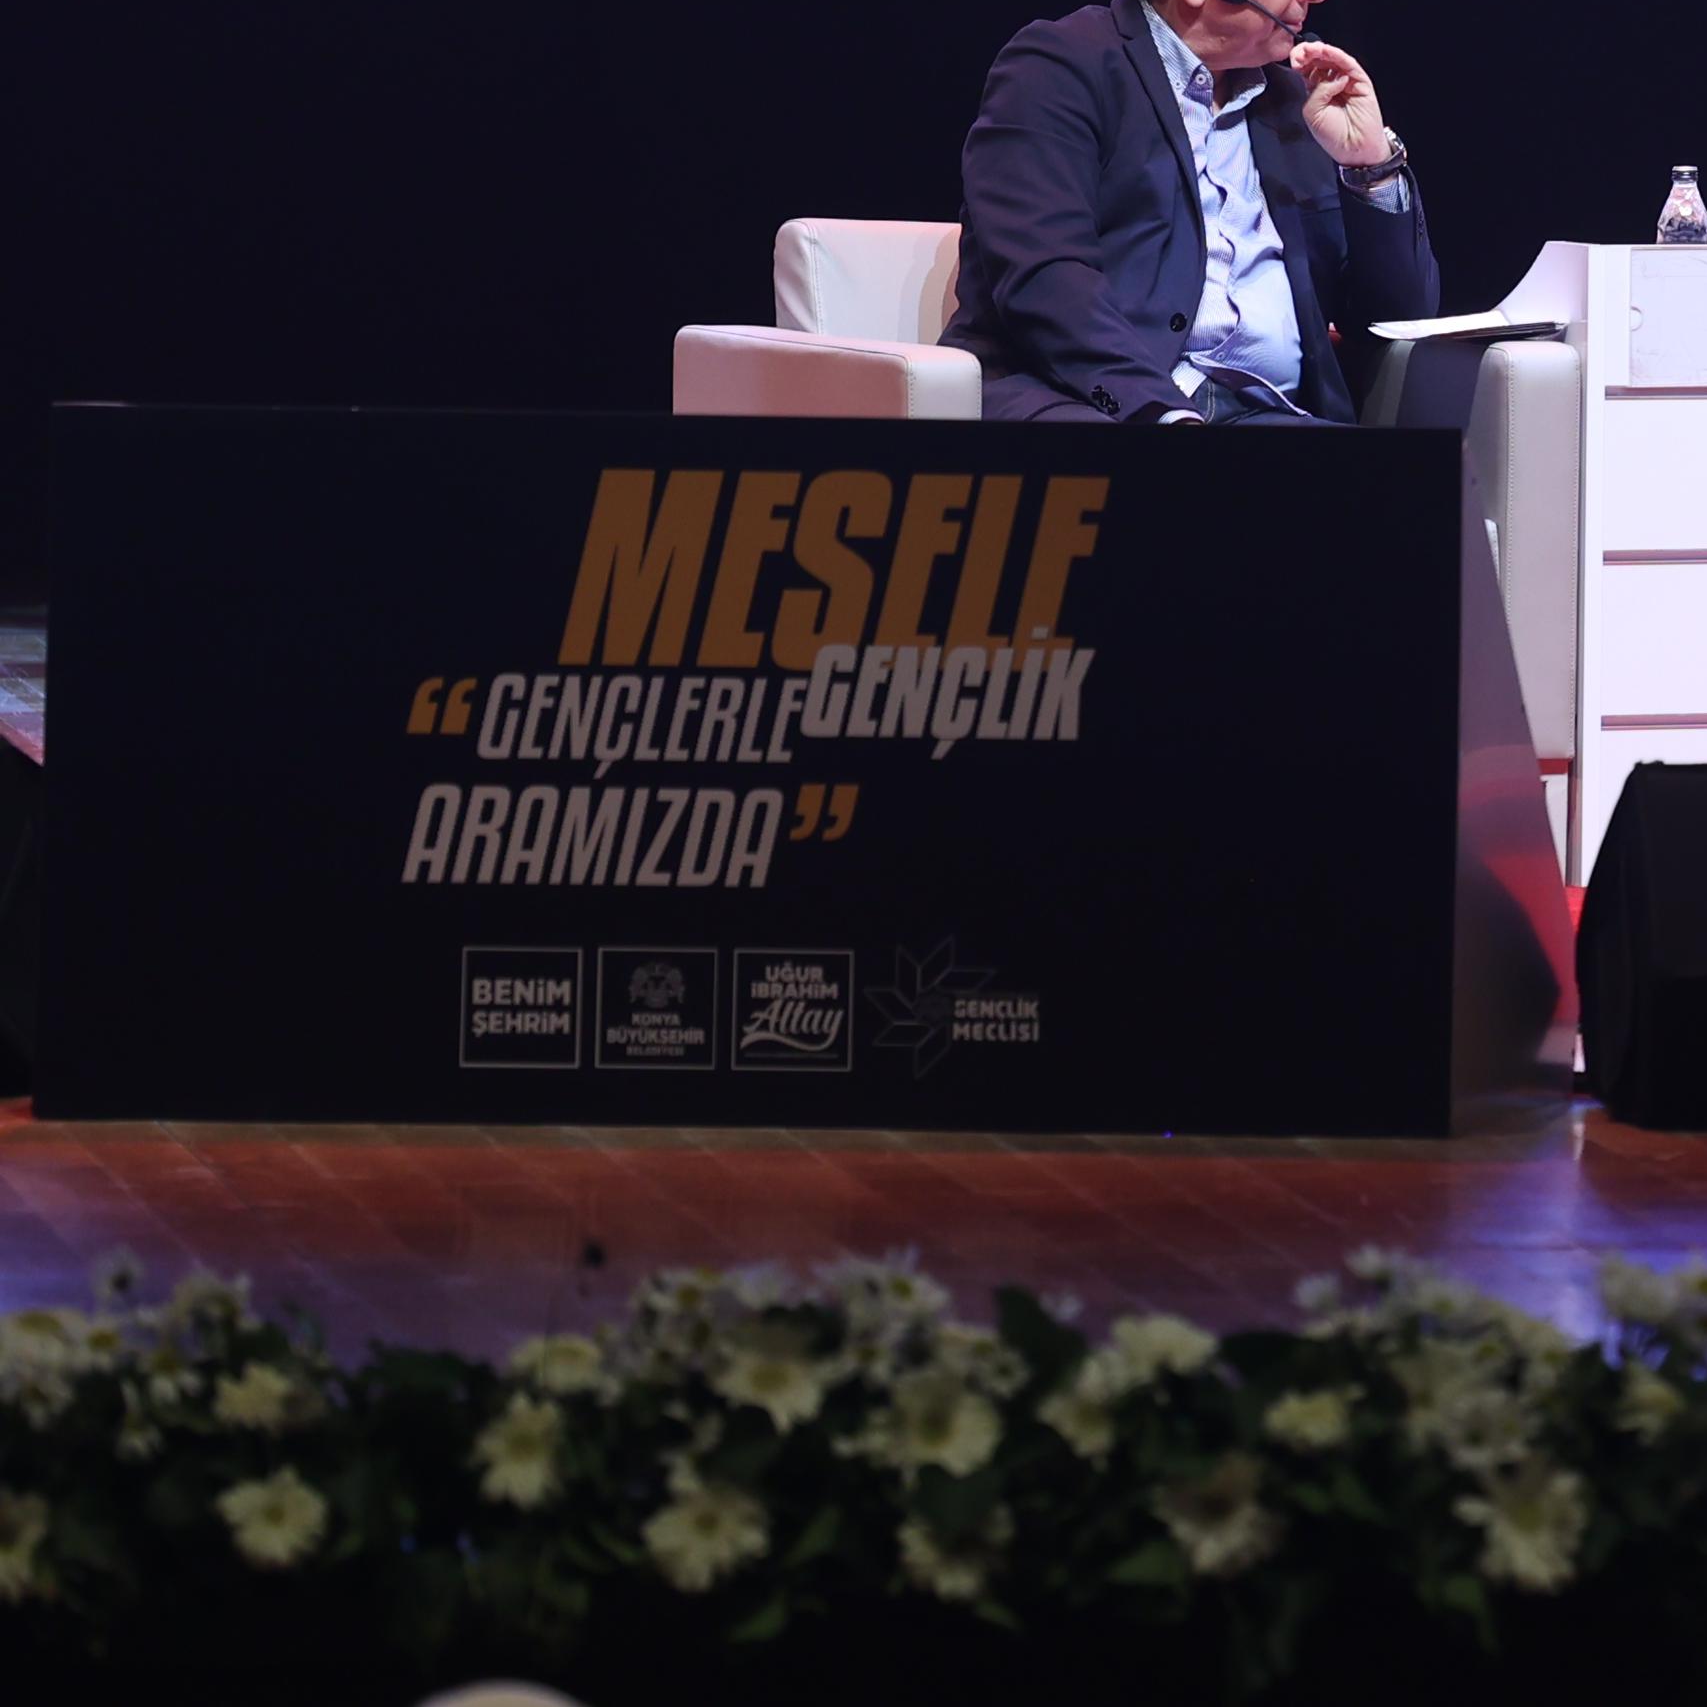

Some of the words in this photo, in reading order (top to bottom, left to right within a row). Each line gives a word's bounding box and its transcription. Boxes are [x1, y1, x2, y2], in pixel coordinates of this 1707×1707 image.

[557, 469, 1111, 672] MESELE
[800, 626, 1096, 760] GENÇLİK
[764, 960, 824, 983] UĞUR
[740, 998, 845, 1052] Altay
[953, 997, 1040, 1020] GENÇLİK
[952, 1020, 1040, 1043] MECLİSİ
